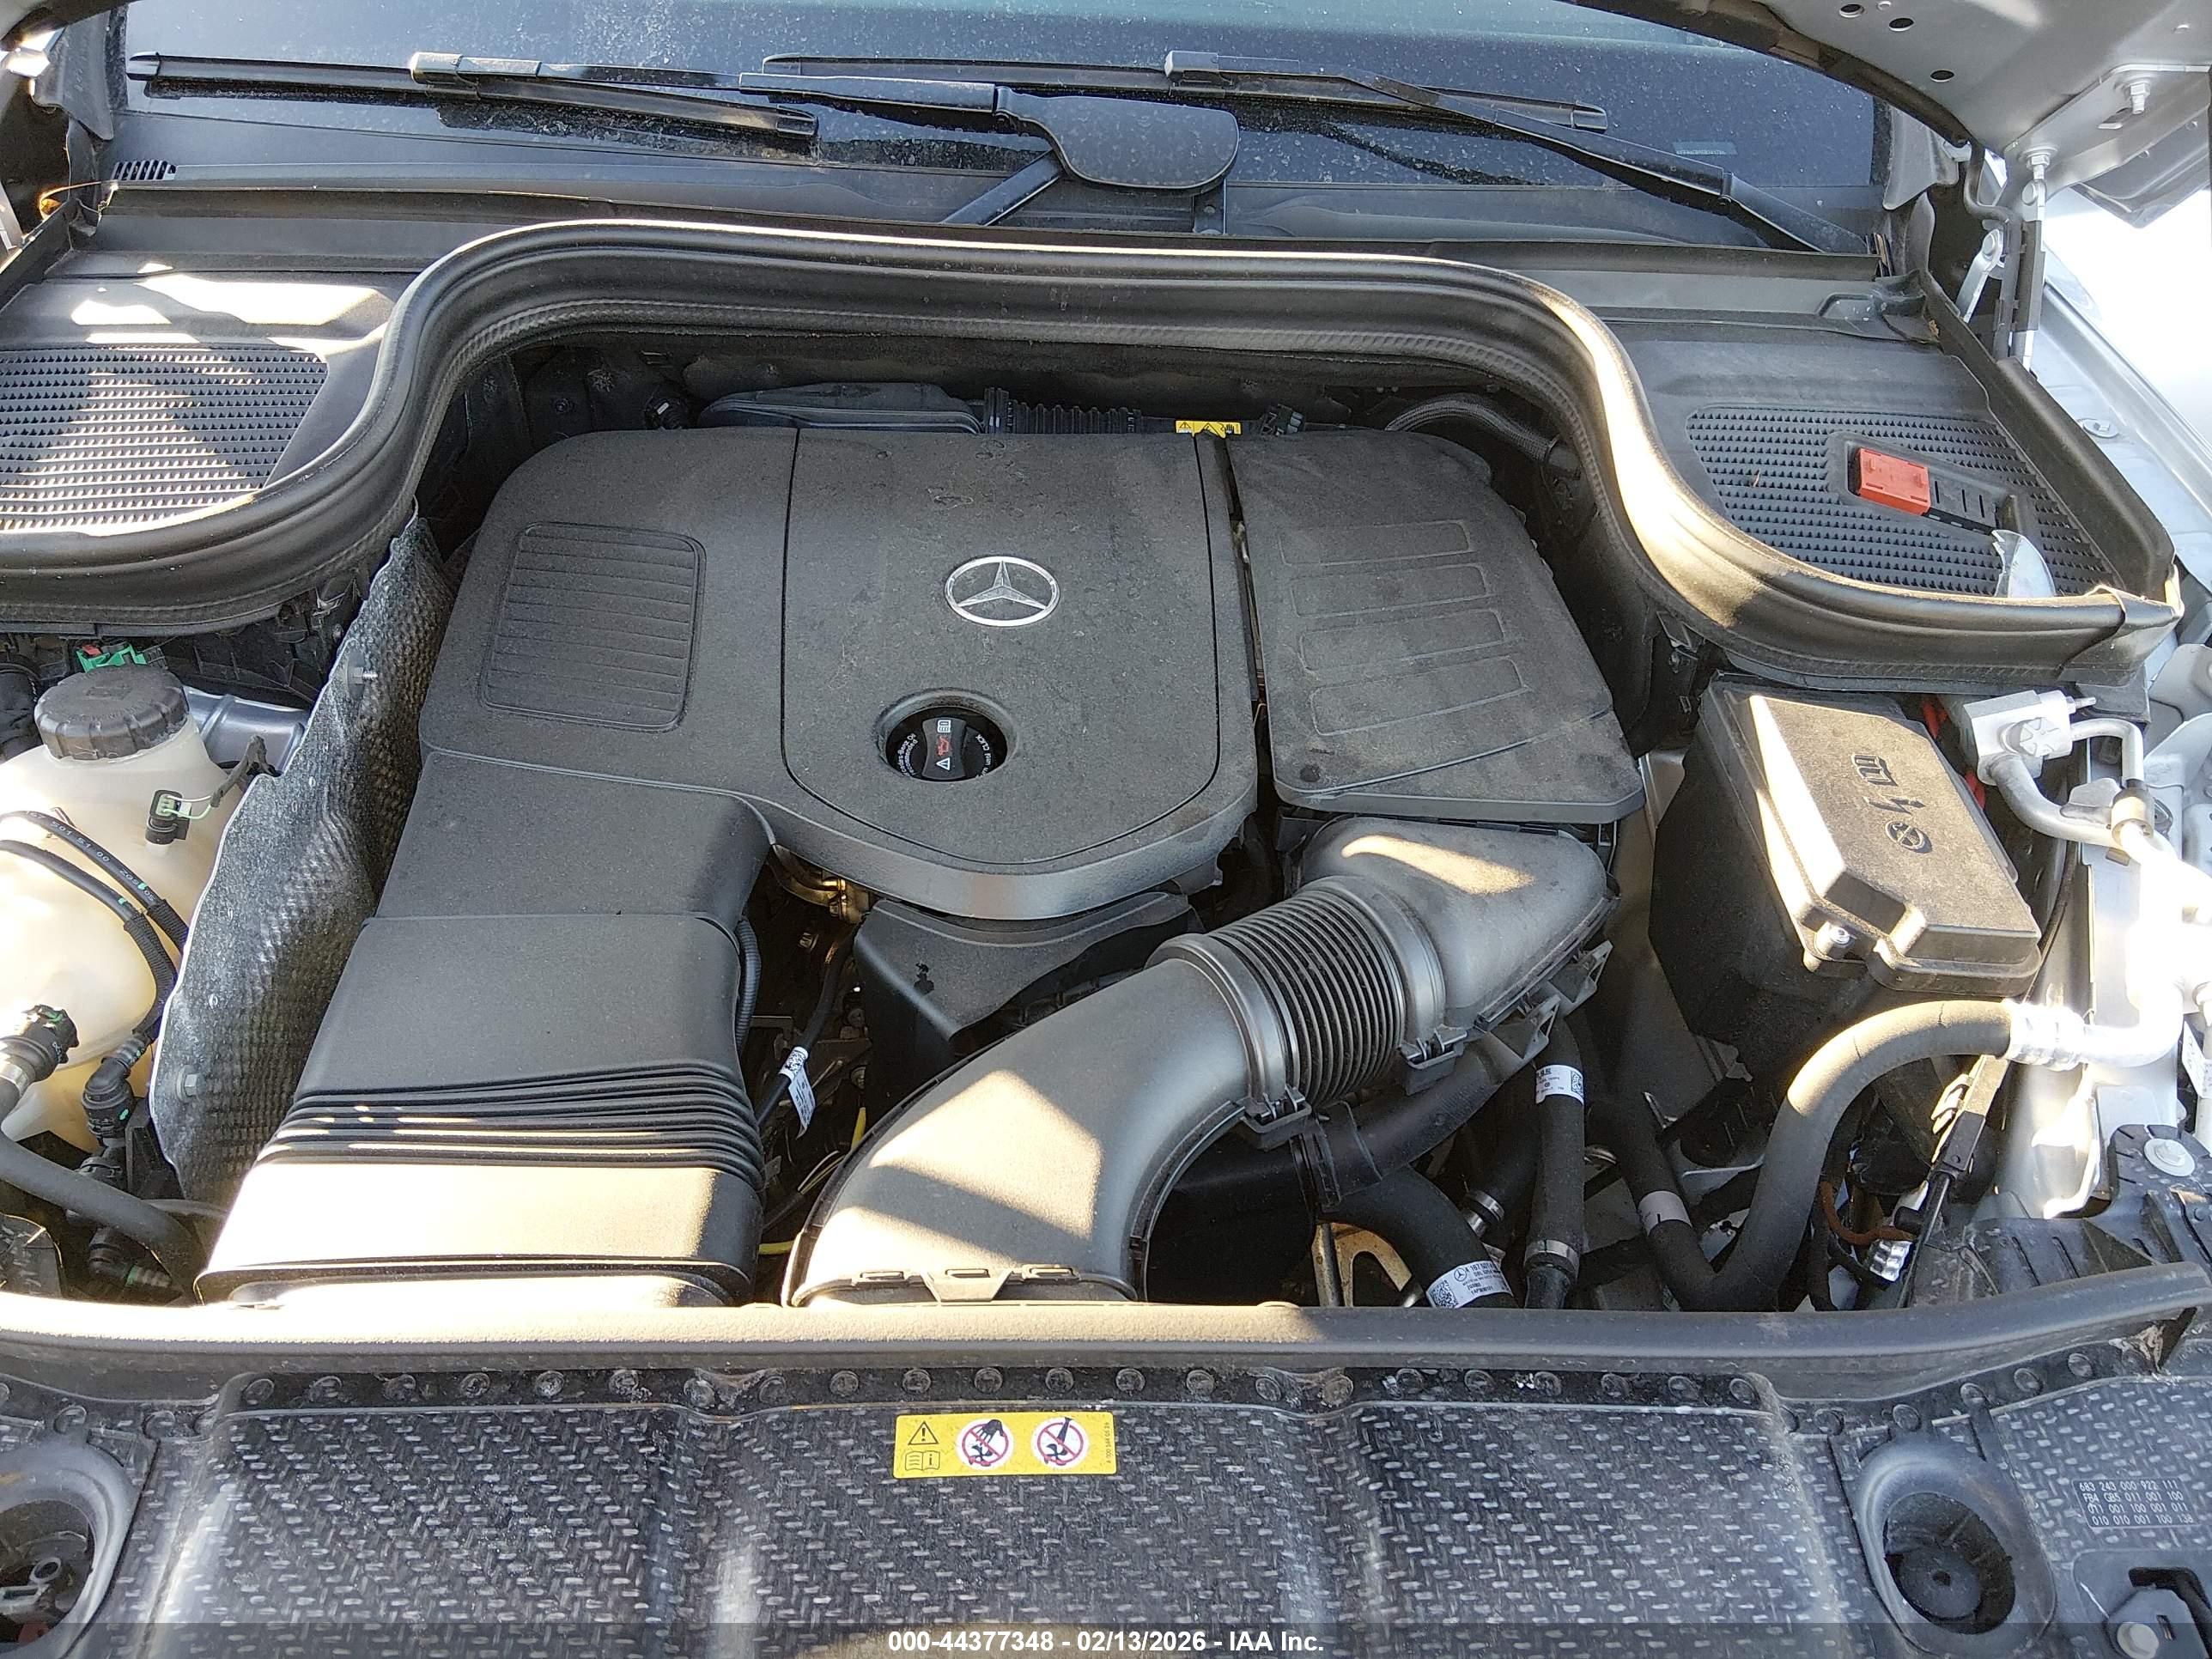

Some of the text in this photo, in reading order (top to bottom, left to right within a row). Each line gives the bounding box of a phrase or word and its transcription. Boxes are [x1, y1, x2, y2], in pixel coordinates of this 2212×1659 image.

[975, 734, 990, 751] CLICK
[50, 820, 73, 836] 501
[2079, 1480, 2179, 1492] 683 243 000 922 111
[2124, 1492, 2142, 1502] 011
[2146, 1492, 2161, 1502] 001
[2167, 1491, 2184, 1501] 100
[2087, 1503, 2188, 1514] 011 001 100 001 011
[2092, 1516, 2109, 1526] 010
[2112, 1516, 2130, 1525] 010
[2134, 1516, 2151, 1525] 001
[2156, 1515, 2172, 1524] 100
